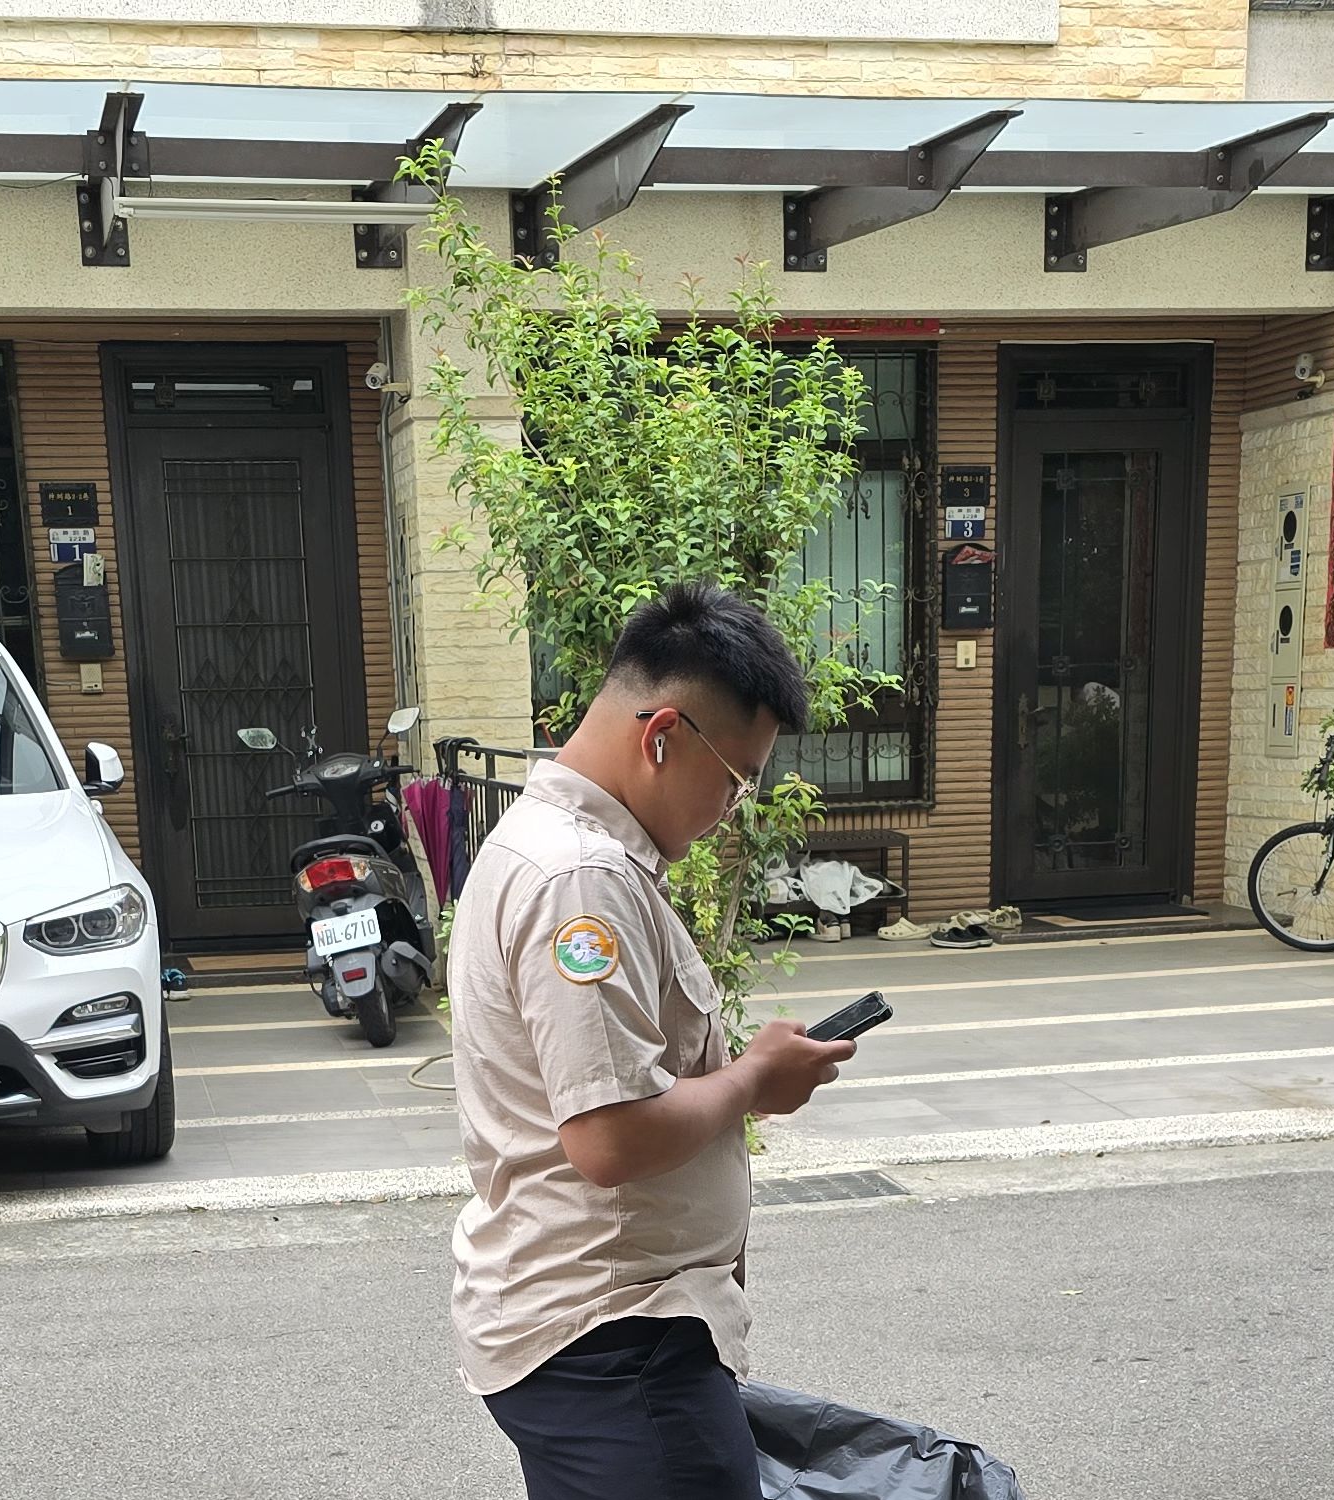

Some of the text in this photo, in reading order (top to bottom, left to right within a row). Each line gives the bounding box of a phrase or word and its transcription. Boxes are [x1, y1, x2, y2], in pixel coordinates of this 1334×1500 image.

[963, 487, 970, 497] 3
[67, 505, 73, 516] 1
[963, 520, 973, 538] 3
[72, 544, 82, 562] 1
[316, 918, 377, 948] NBL-6710
